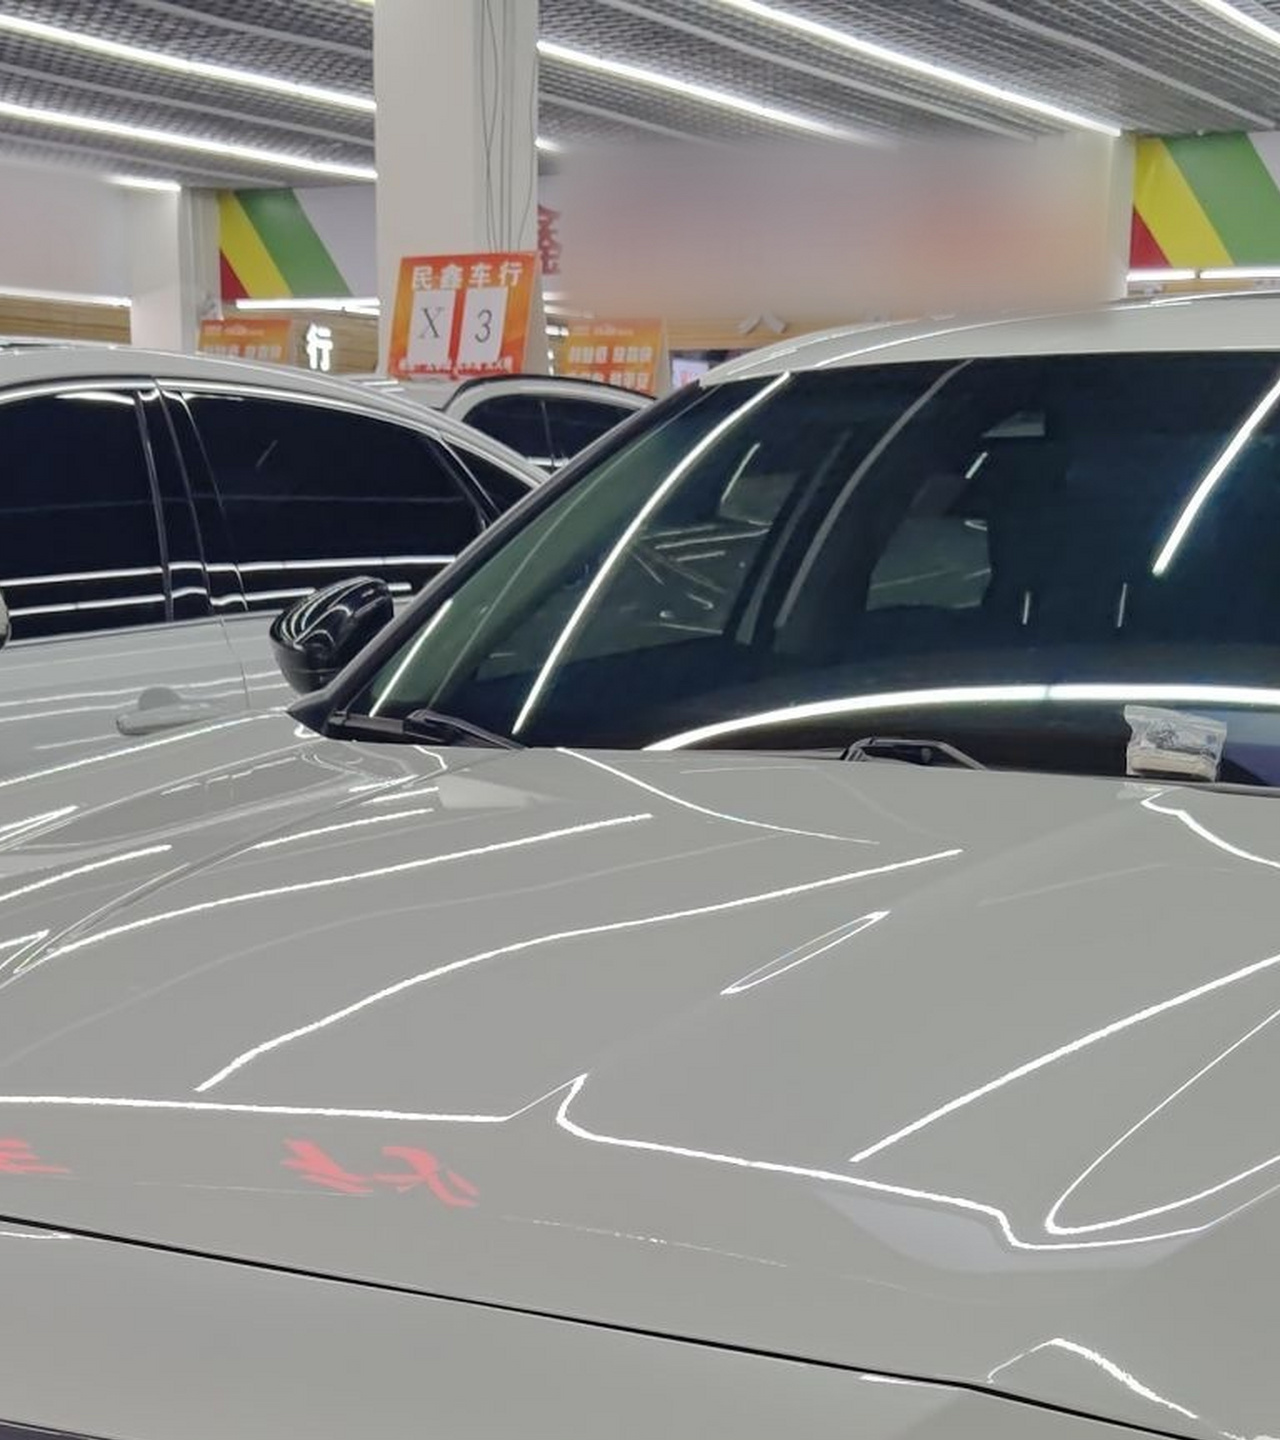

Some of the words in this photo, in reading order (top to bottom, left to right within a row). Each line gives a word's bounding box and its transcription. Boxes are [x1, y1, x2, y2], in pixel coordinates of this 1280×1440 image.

[412, 261, 523, 291] 民鑫车行
[418, 306, 446, 340] X
[474, 308, 493, 343] 3
